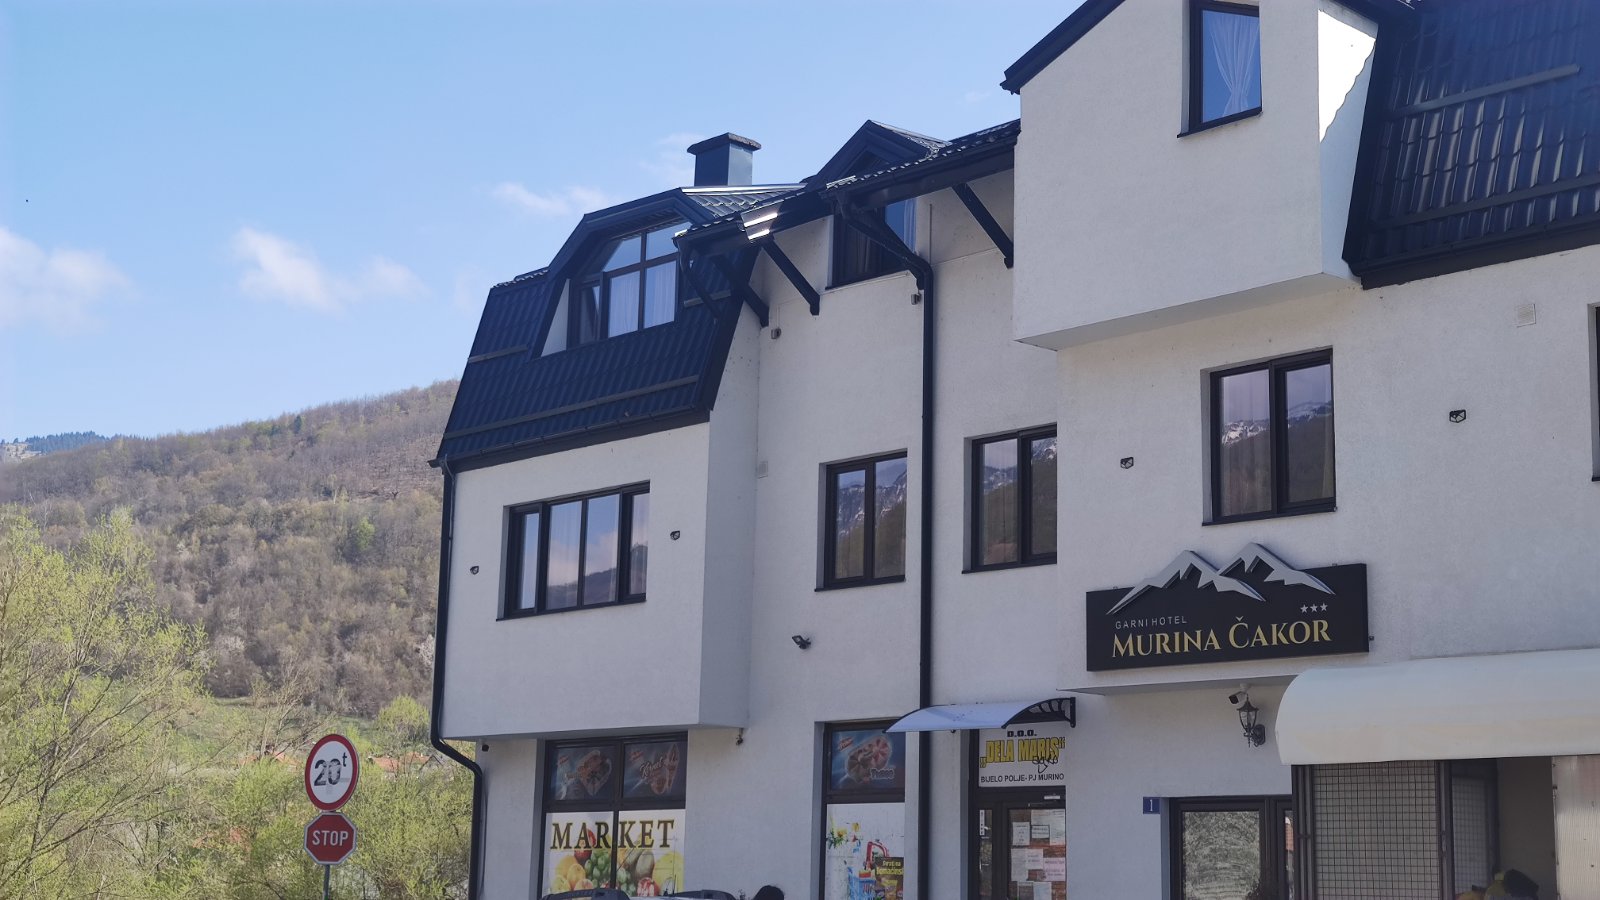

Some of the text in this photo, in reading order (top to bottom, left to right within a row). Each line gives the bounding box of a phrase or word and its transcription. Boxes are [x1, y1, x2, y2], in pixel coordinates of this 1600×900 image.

[1115, 615, 1187, 630] GARNI HOTEL
[1112, 615, 1332, 658] MURINA ČAKOR
[981, 775, 1003, 783] BIJELO
[1029, 773, 1037, 781] PJ
[1038, 772, 1065, 781] MURINO
[1149, 799, 1153, 812] 1
[312, 830, 349, 846] STOP
[549, 819, 675, 850] MARKET
